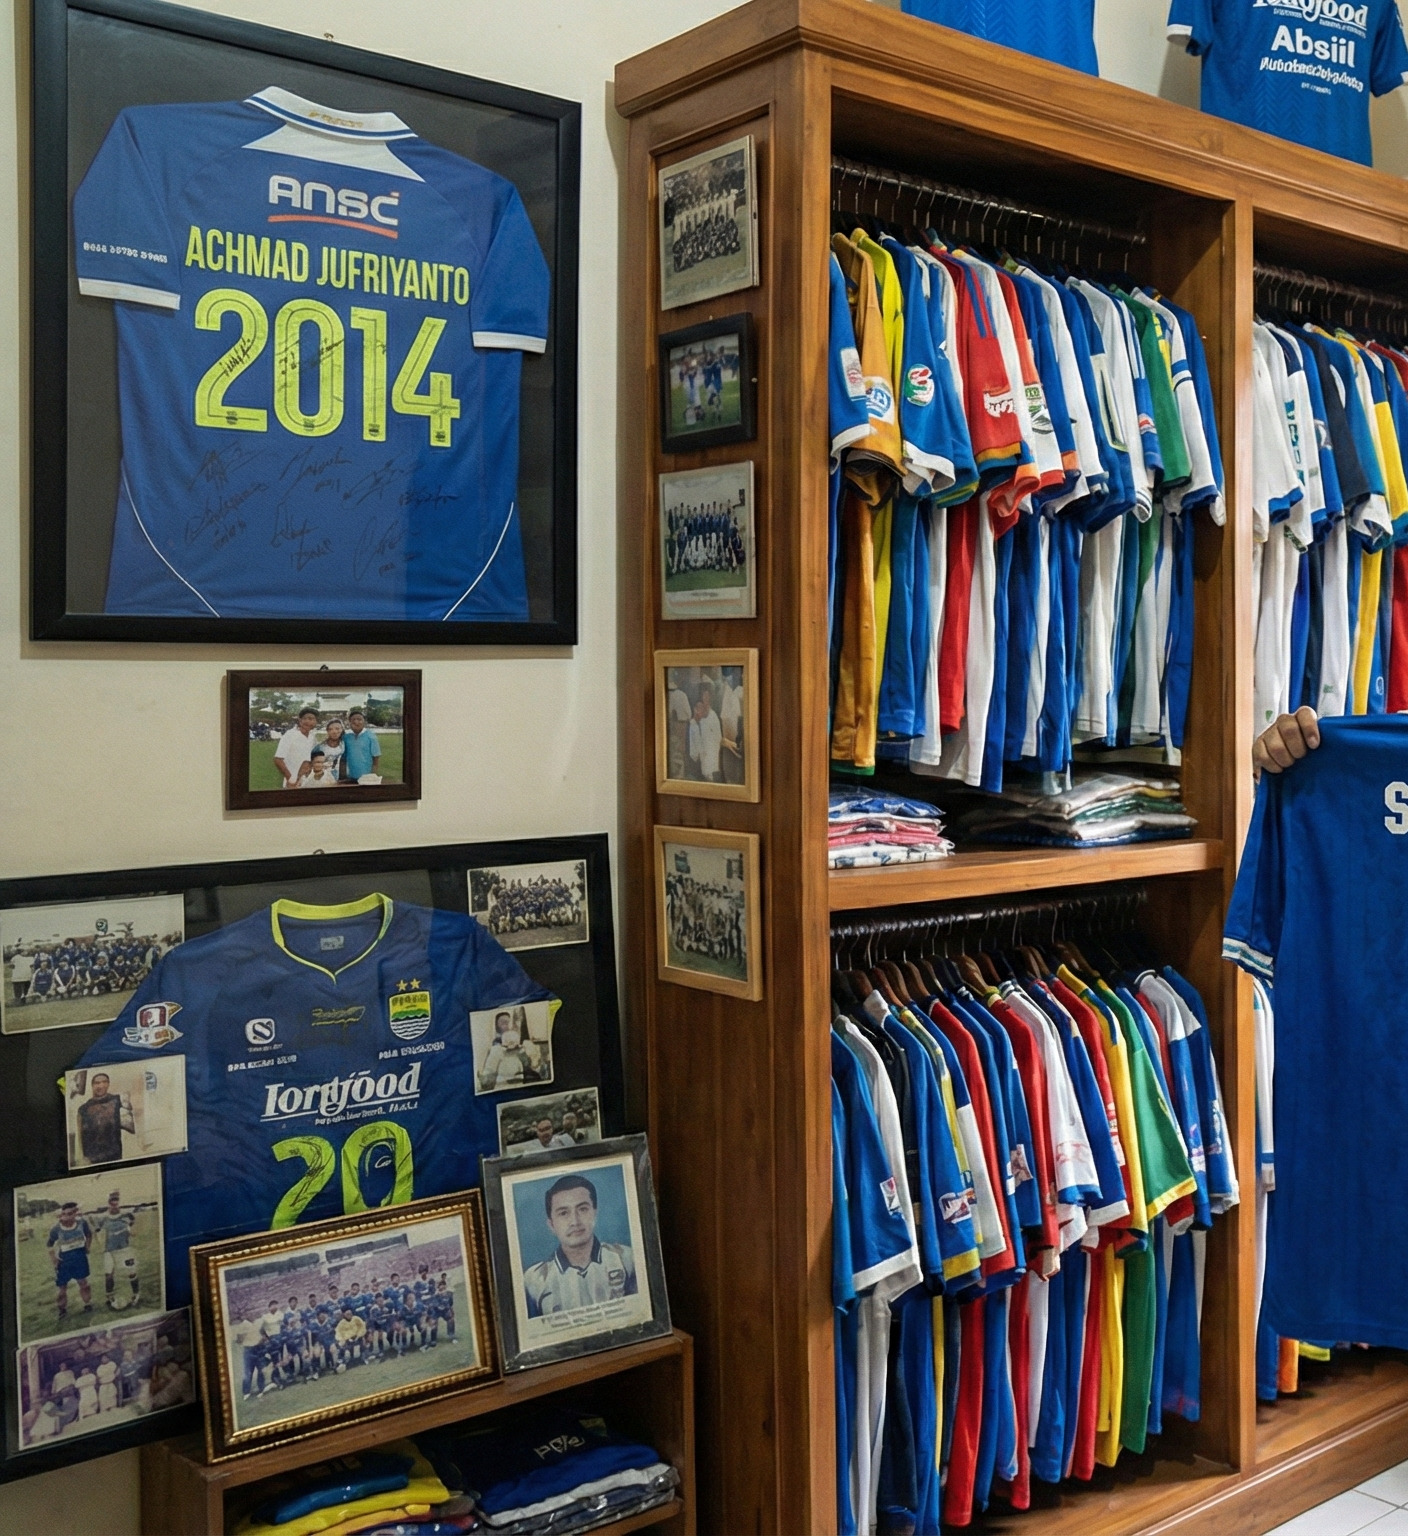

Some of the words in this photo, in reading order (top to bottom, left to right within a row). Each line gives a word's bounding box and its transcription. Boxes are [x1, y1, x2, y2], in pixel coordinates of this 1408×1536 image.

[1271, 25, 1355, 68] Absiil
[185, 225, 309, 284] ACHMAD
[316, 248, 470, 306] JUFRIYANTO
[193, 288, 461, 448] 2014
[270, 1120, 414, 1231] 20
